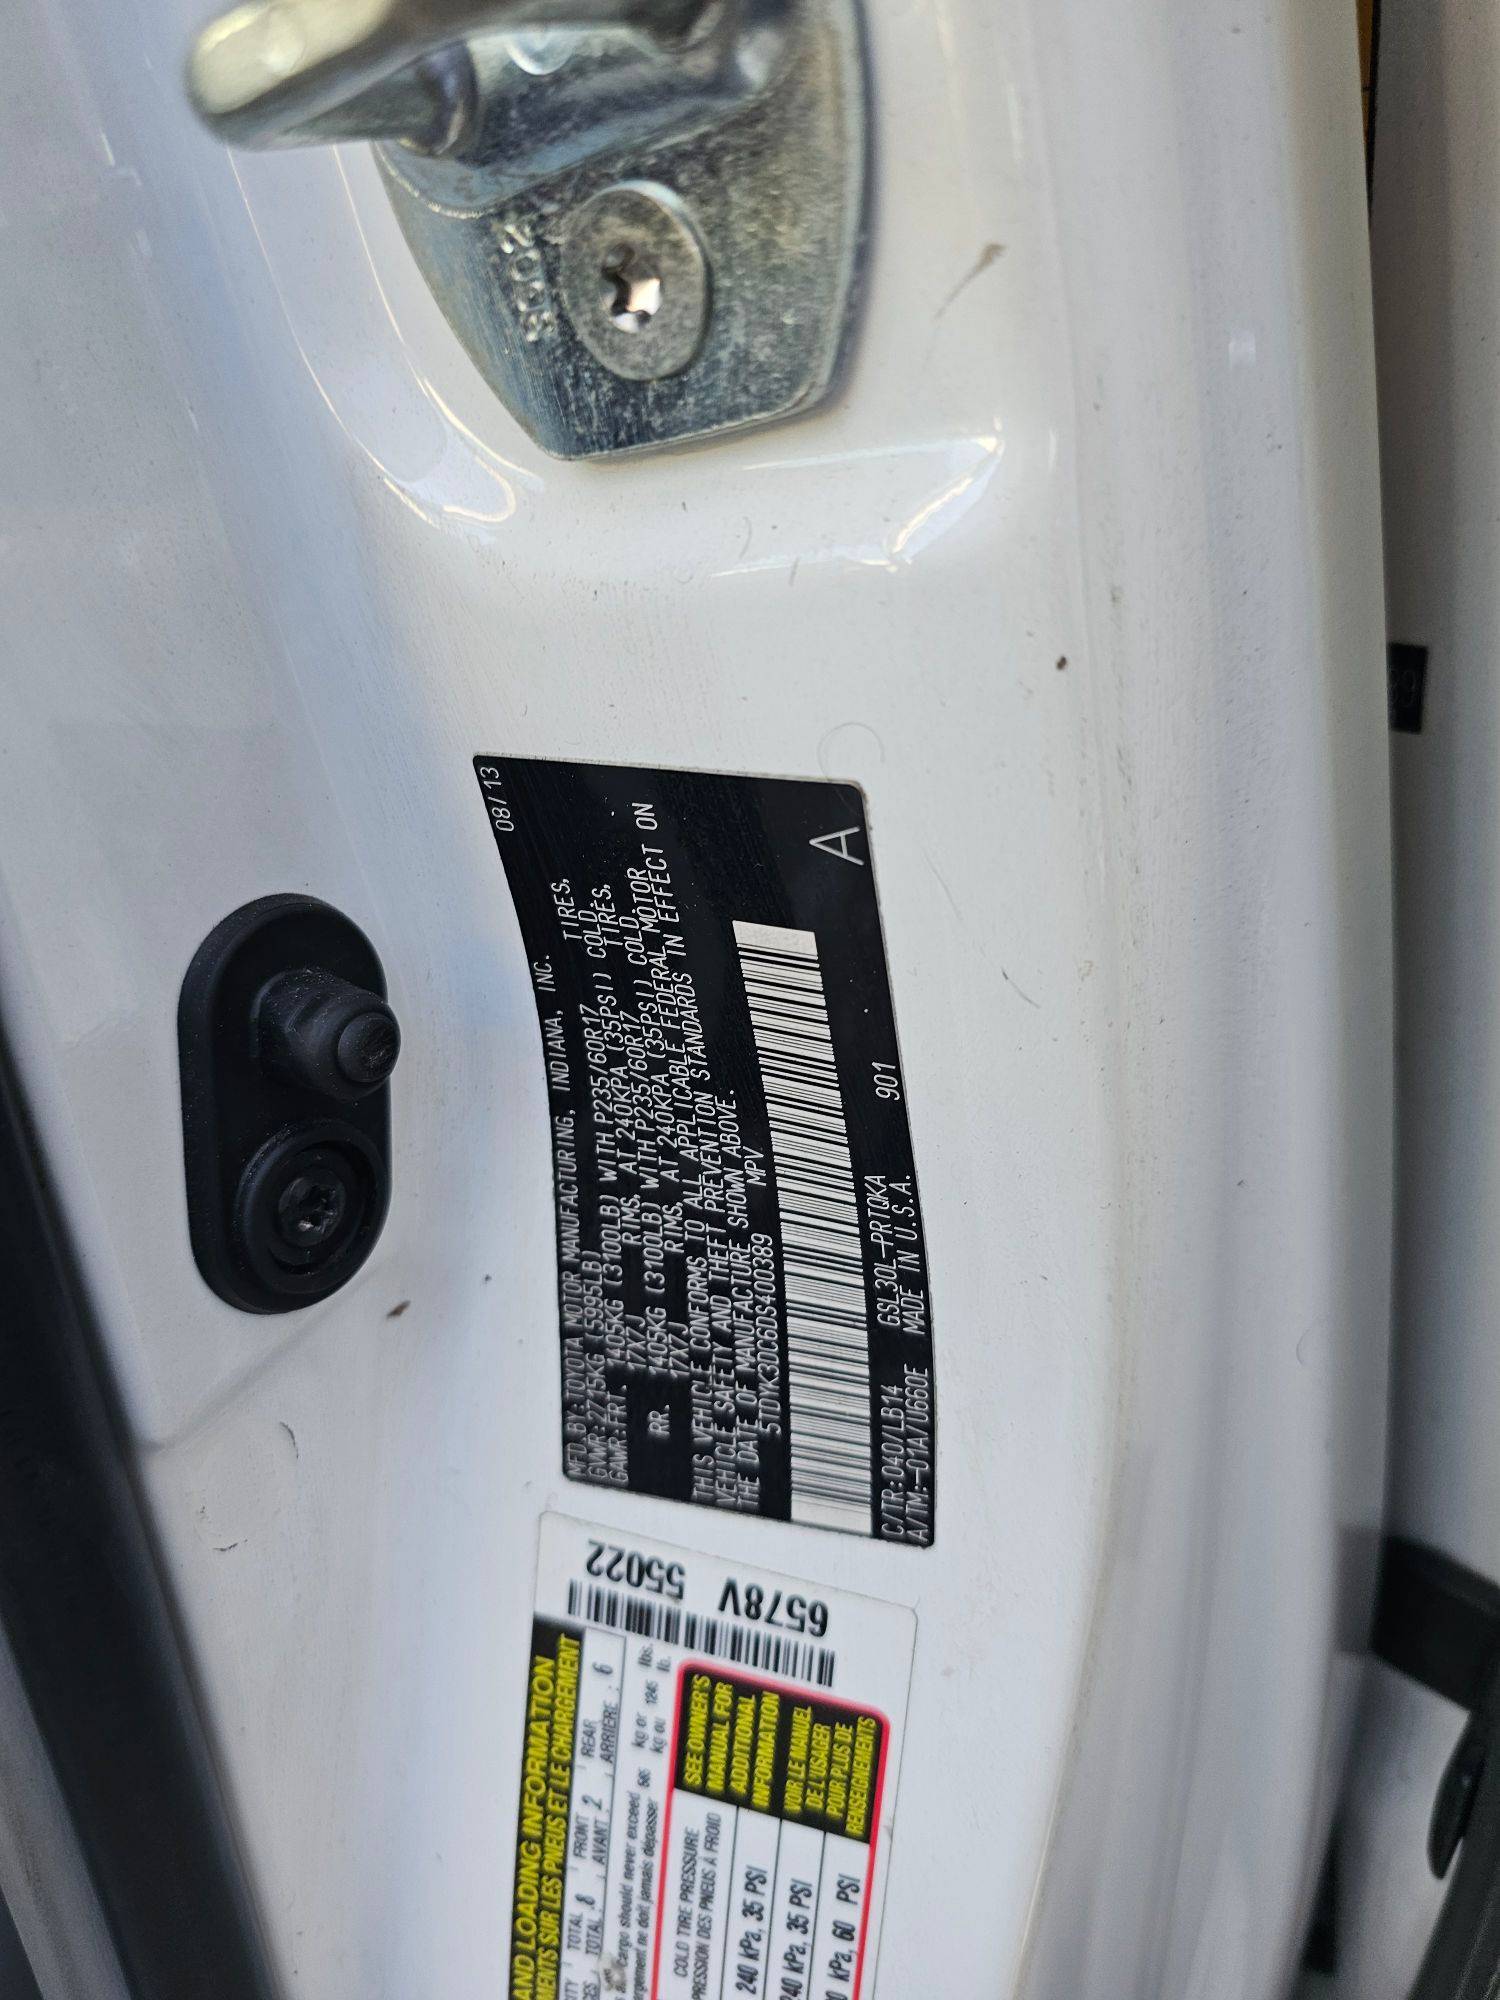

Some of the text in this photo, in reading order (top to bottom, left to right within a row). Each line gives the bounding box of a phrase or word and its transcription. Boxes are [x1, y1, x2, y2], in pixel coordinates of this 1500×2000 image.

[808, 826, 865, 866] A
[551, 878, 582, 940] TIRES,
[533, 955, 556, 992] INC.
[545, 1010, 570, 1091] INDIANA,
[580, 1003, 614, 1124] P235/60R17
[871, 1061, 900, 1100] 901
[577, 902, 647, 1371] 17X7J RIMS, AT 240KPA (35PSI) COLD.
[596, 1132, 618, 1181] WITH
[619, 908, 690, 1379] 17X7J RIMS, AT 240KPA (35PSI) COLD.
[631, 802, 738, 1509] VEHICLE SAFETY AND THEFT PREVENTION STANDARDS IN EFFECT ON
[555, 1109, 580, 1262] MANUFACTURING,
[591, 884, 670, 1439] RR. 1405KG (3100LB) WITH P235/60R17 TIRES,
[626, 868, 715, 1498] THIS VEHICLE CONFORMS TO ALL APPLICABLE FEDERAL MOTOR
[742, 1145, 767, 1186] MPV
[600, 1194, 623, 1286] (3100LB)
[889, 1174, 926, 1336] MADE IN U.S.A.
[562, 1271, 583, 1328] MOTOR
[581, 1250, 604, 1340] (5995LB)
[714, 1089, 760, 1510] THE DATE OF MANUFACTURE SHOWN ABOVE.
[604, 1299, 627, 1367] 1405KG
[880, 1384, 905, 1536] C/TR:040/LB14
[586, 1539, 686, 1601] 55022
[717, 1577, 828, 1637] 6578V
[591, 1661, 613, 1677] 6
[551, 1633, 580, 1761] CHARGEMENT
[635, 1712, 647, 1729] or
[580, 1719, 598, 1759] REAR
[631, 1729, 648, 1748] kg
[683, 1674, 712, 1786] SEE OWNER'S
[706, 1681, 733, 1793] MANUAL FOR
[730, 1695, 756, 1795] ADDITIONAL
[752, 1690, 780, 1809] INFORMATION
[550, 1762, 571, 1789] LE
[783, 1706, 812, 1812] VOIR LE MANUEL
[826, 1721, 853, 1818] POUR PLUS DE
[845, 1715, 877, 1836] RENSEIGNEMENTS
[547, 1788, 569, 1814] ET
[580, 1794, 602, 1812] 2
[624, 1790, 641, 1840] exceed
[804, 1787, 825, 1810] DE
[512, 1655, 556, 2000] AND LOADING INFORMATION
[543, 1813, 567, 1874] PNEUS
[572, 1812, 590, 1859] FRONT
[592, 1817, 610, 1866] AVANT
[703, 1812, 722, 1853] FROID
[622, 1844, 636, 1880] never
[639, 1860, 655, 1904] jamais
[744, 1865, 768, 1896] PSI
[541, 1874, 563, 1910] LES
[617, 1883, 633, 1928] should
[673, 1826, 700, 1978] COLD TIRE PRESSURE
[698, 1867, 717, 1912] PNEUS
[741, 1899, 764, 1922] 35
[789, 1878, 812, 1909] PSI
[835, 1873, 861, 1906] PSI
[539, 1910, 561, 1946] SUR
[567, 1912, 583, 1950] TOTAL
[585, 1917, 601, 1955] TOTAL
[636, 1904, 650, 1928] doit
[636, 1931, 648, 1945] ne
[696, 1914, 713, 1940] DES
[786, 1911, 809, 1935] 35
[831, 1920, 856, 1941] 60
[618, 1931, 634, 1967] cargo
[691, 1941, 710, 2000] PRESSION
[734, 1964, 759, 1995] 240
